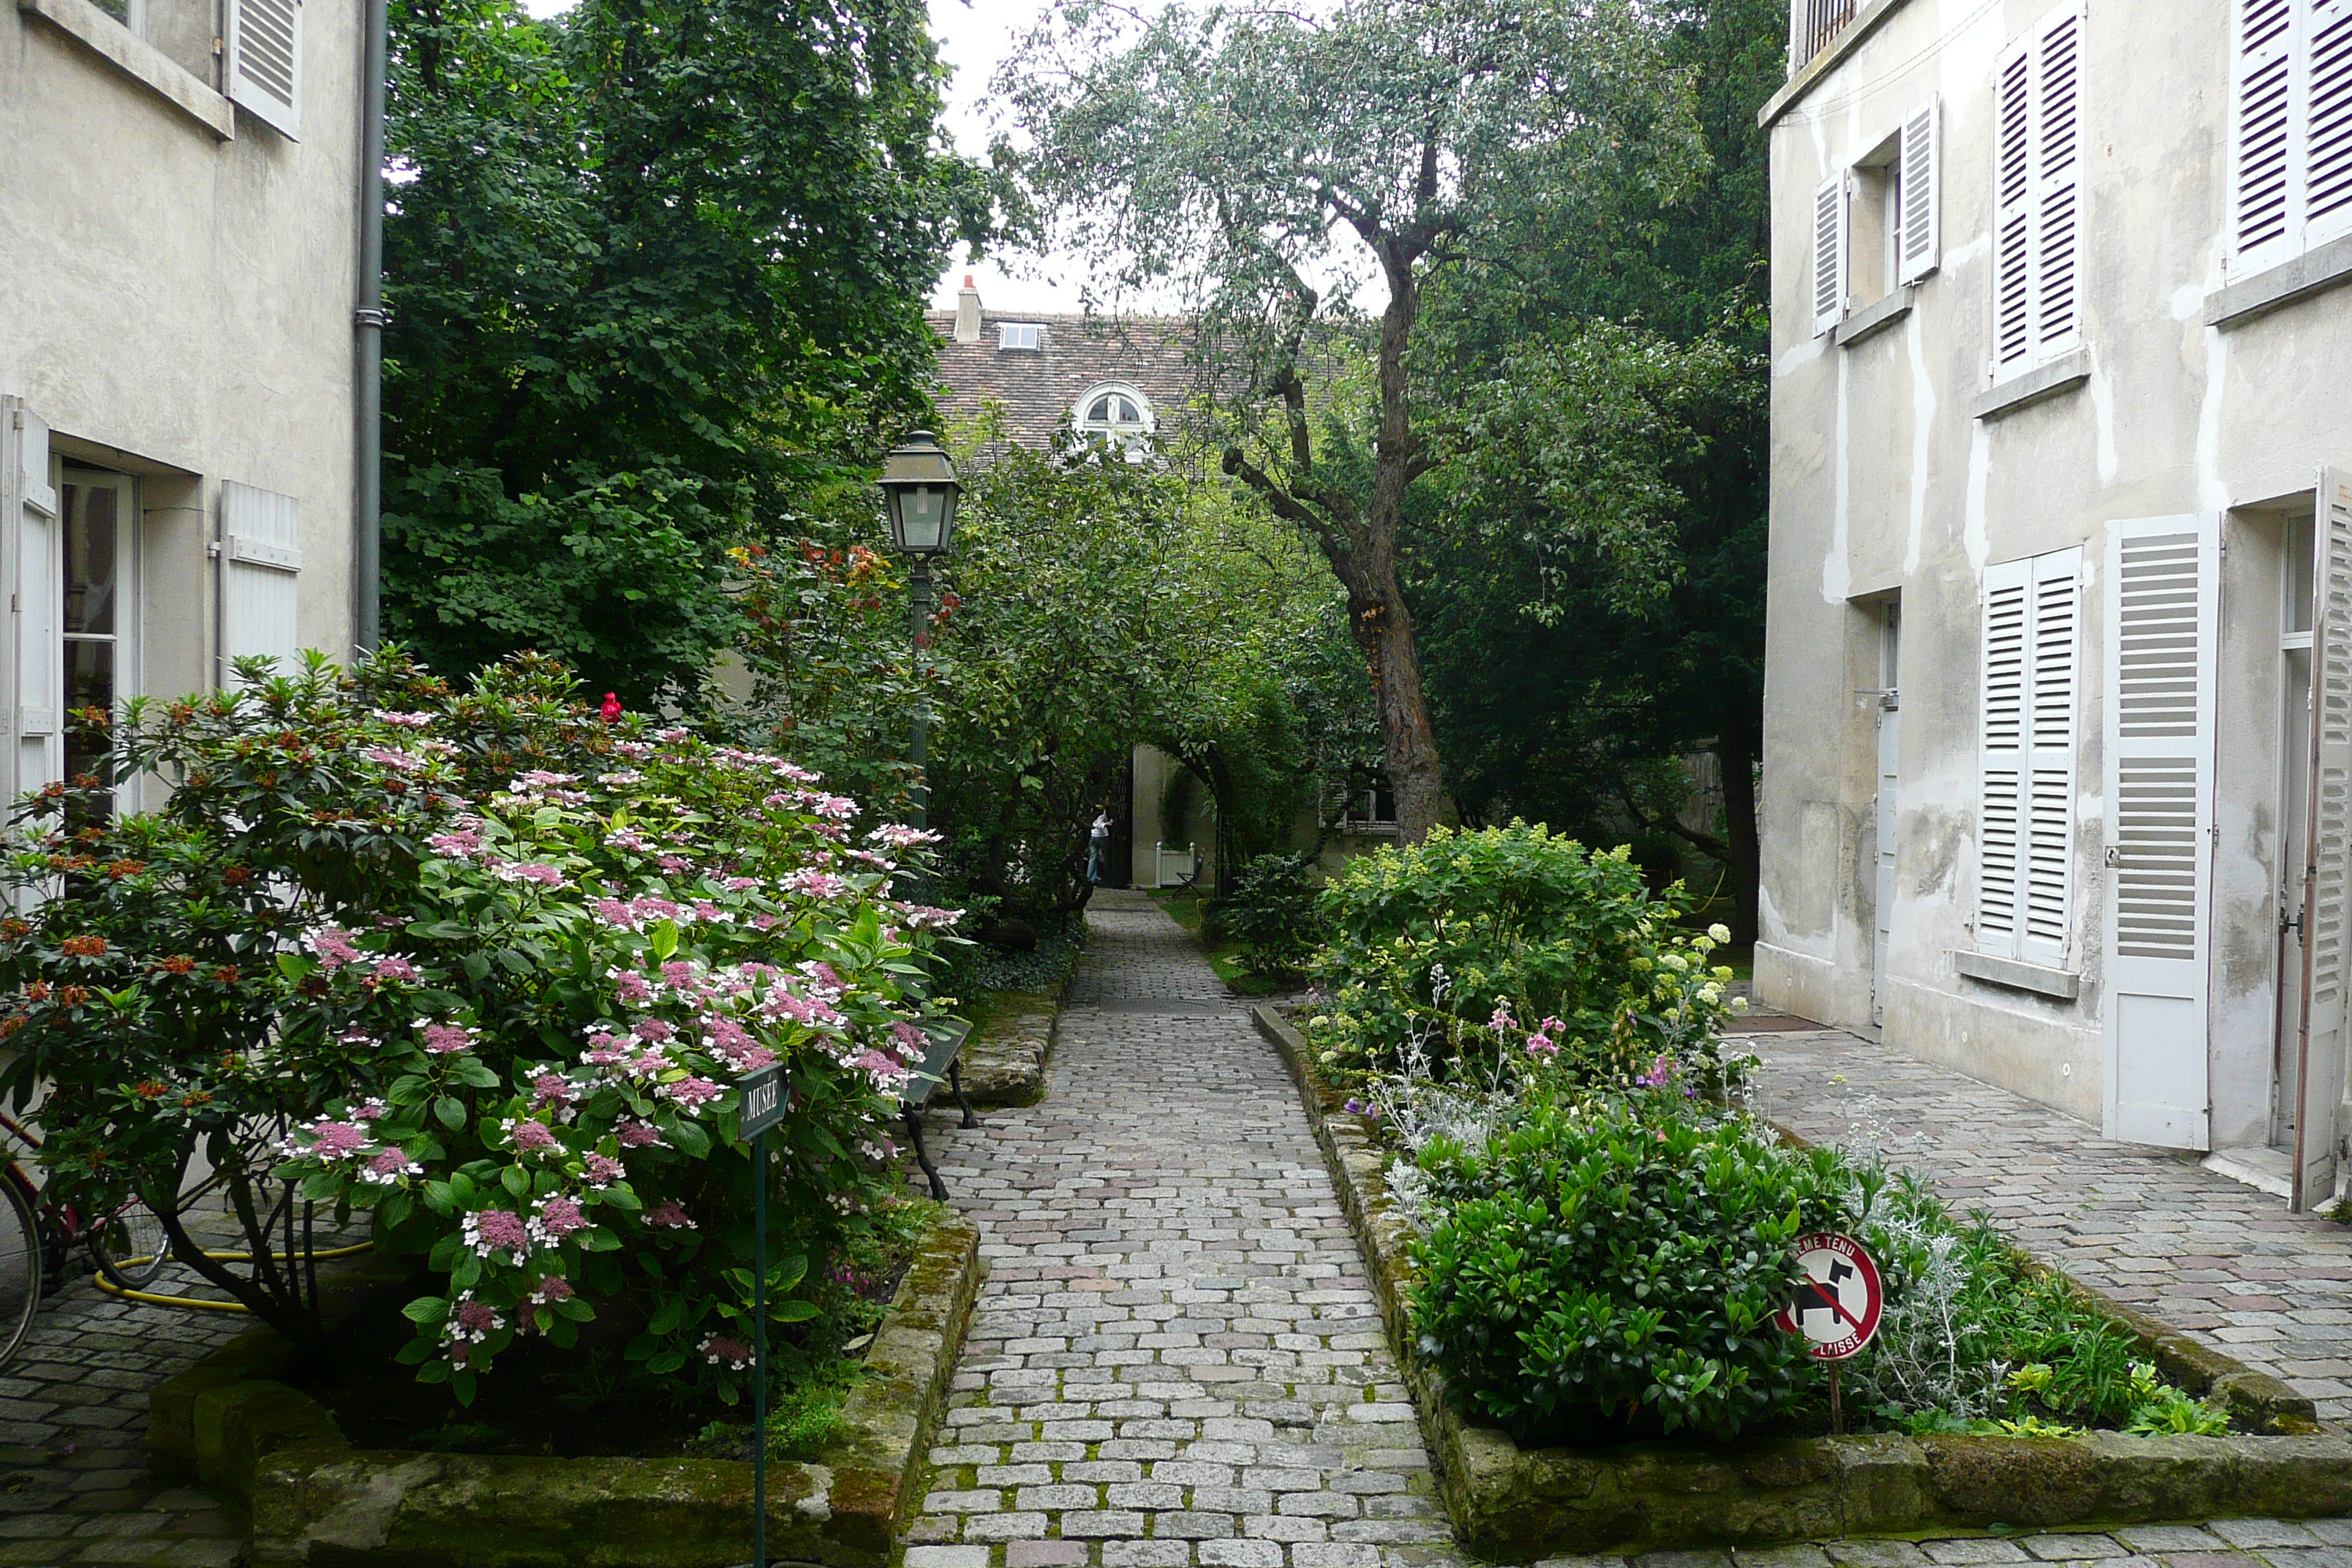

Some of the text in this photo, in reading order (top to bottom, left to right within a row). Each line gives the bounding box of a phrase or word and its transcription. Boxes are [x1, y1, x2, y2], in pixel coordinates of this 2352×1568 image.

[747, 1074, 777, 1121] MUSÉE
[1825, 1237, 1855, 1257] TENU
[1820, 1333, 1861, 1355] LAISSE
